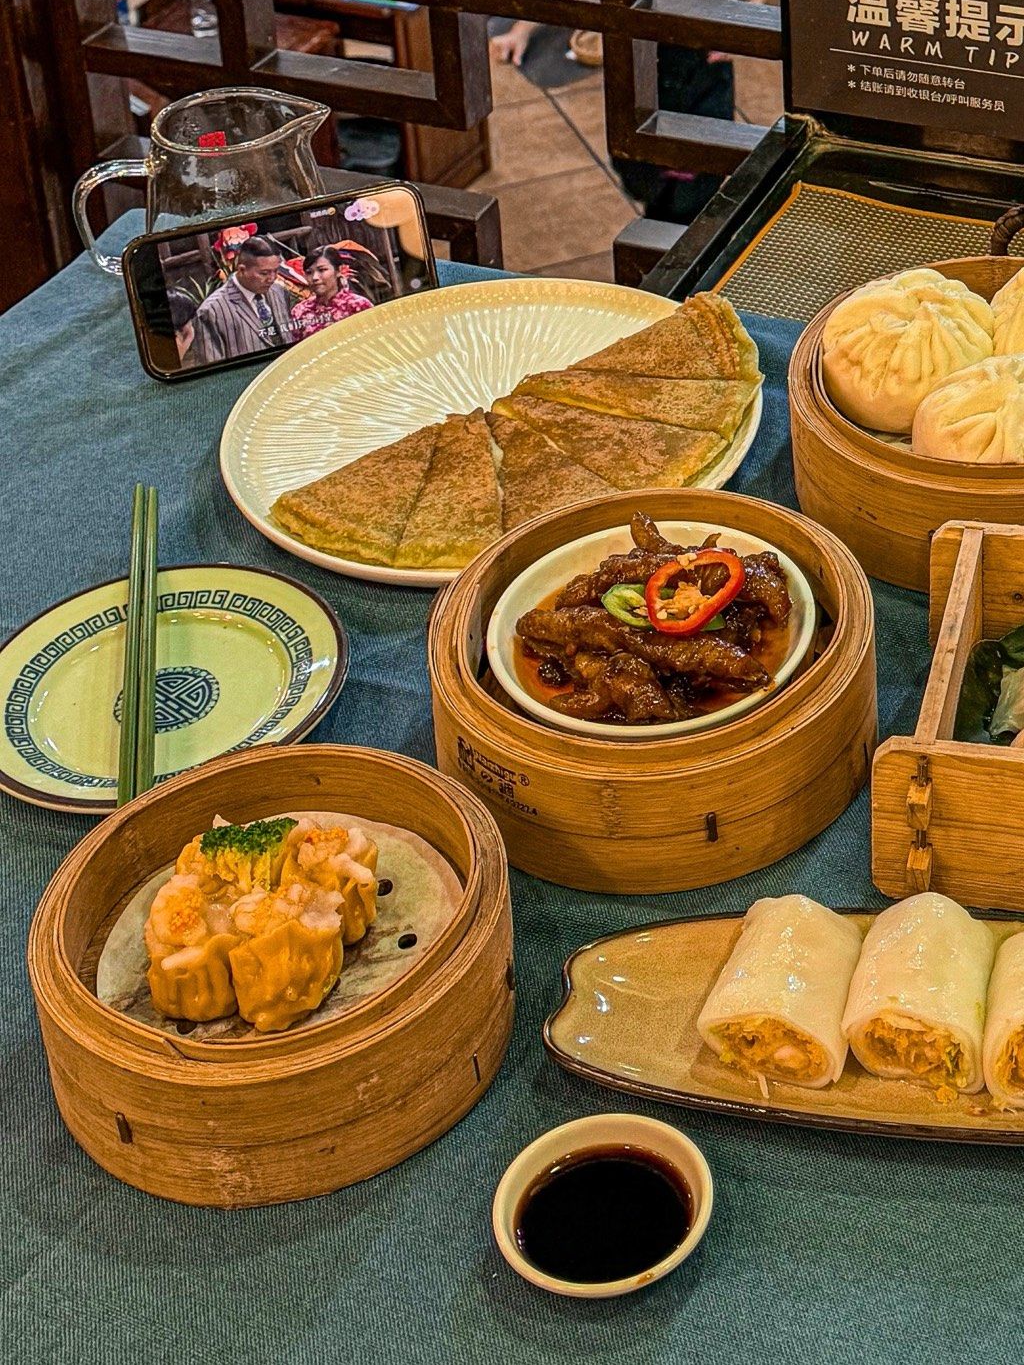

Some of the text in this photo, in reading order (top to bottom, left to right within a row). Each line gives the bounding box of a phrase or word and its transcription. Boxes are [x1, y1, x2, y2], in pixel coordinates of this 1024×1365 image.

[851, 30, 943, 59] WARM
[859, 65, 965, 90] 下单后请勿随意转台
[860, 81, 1006, 113] 结账请到收银台/呼叫服务员
